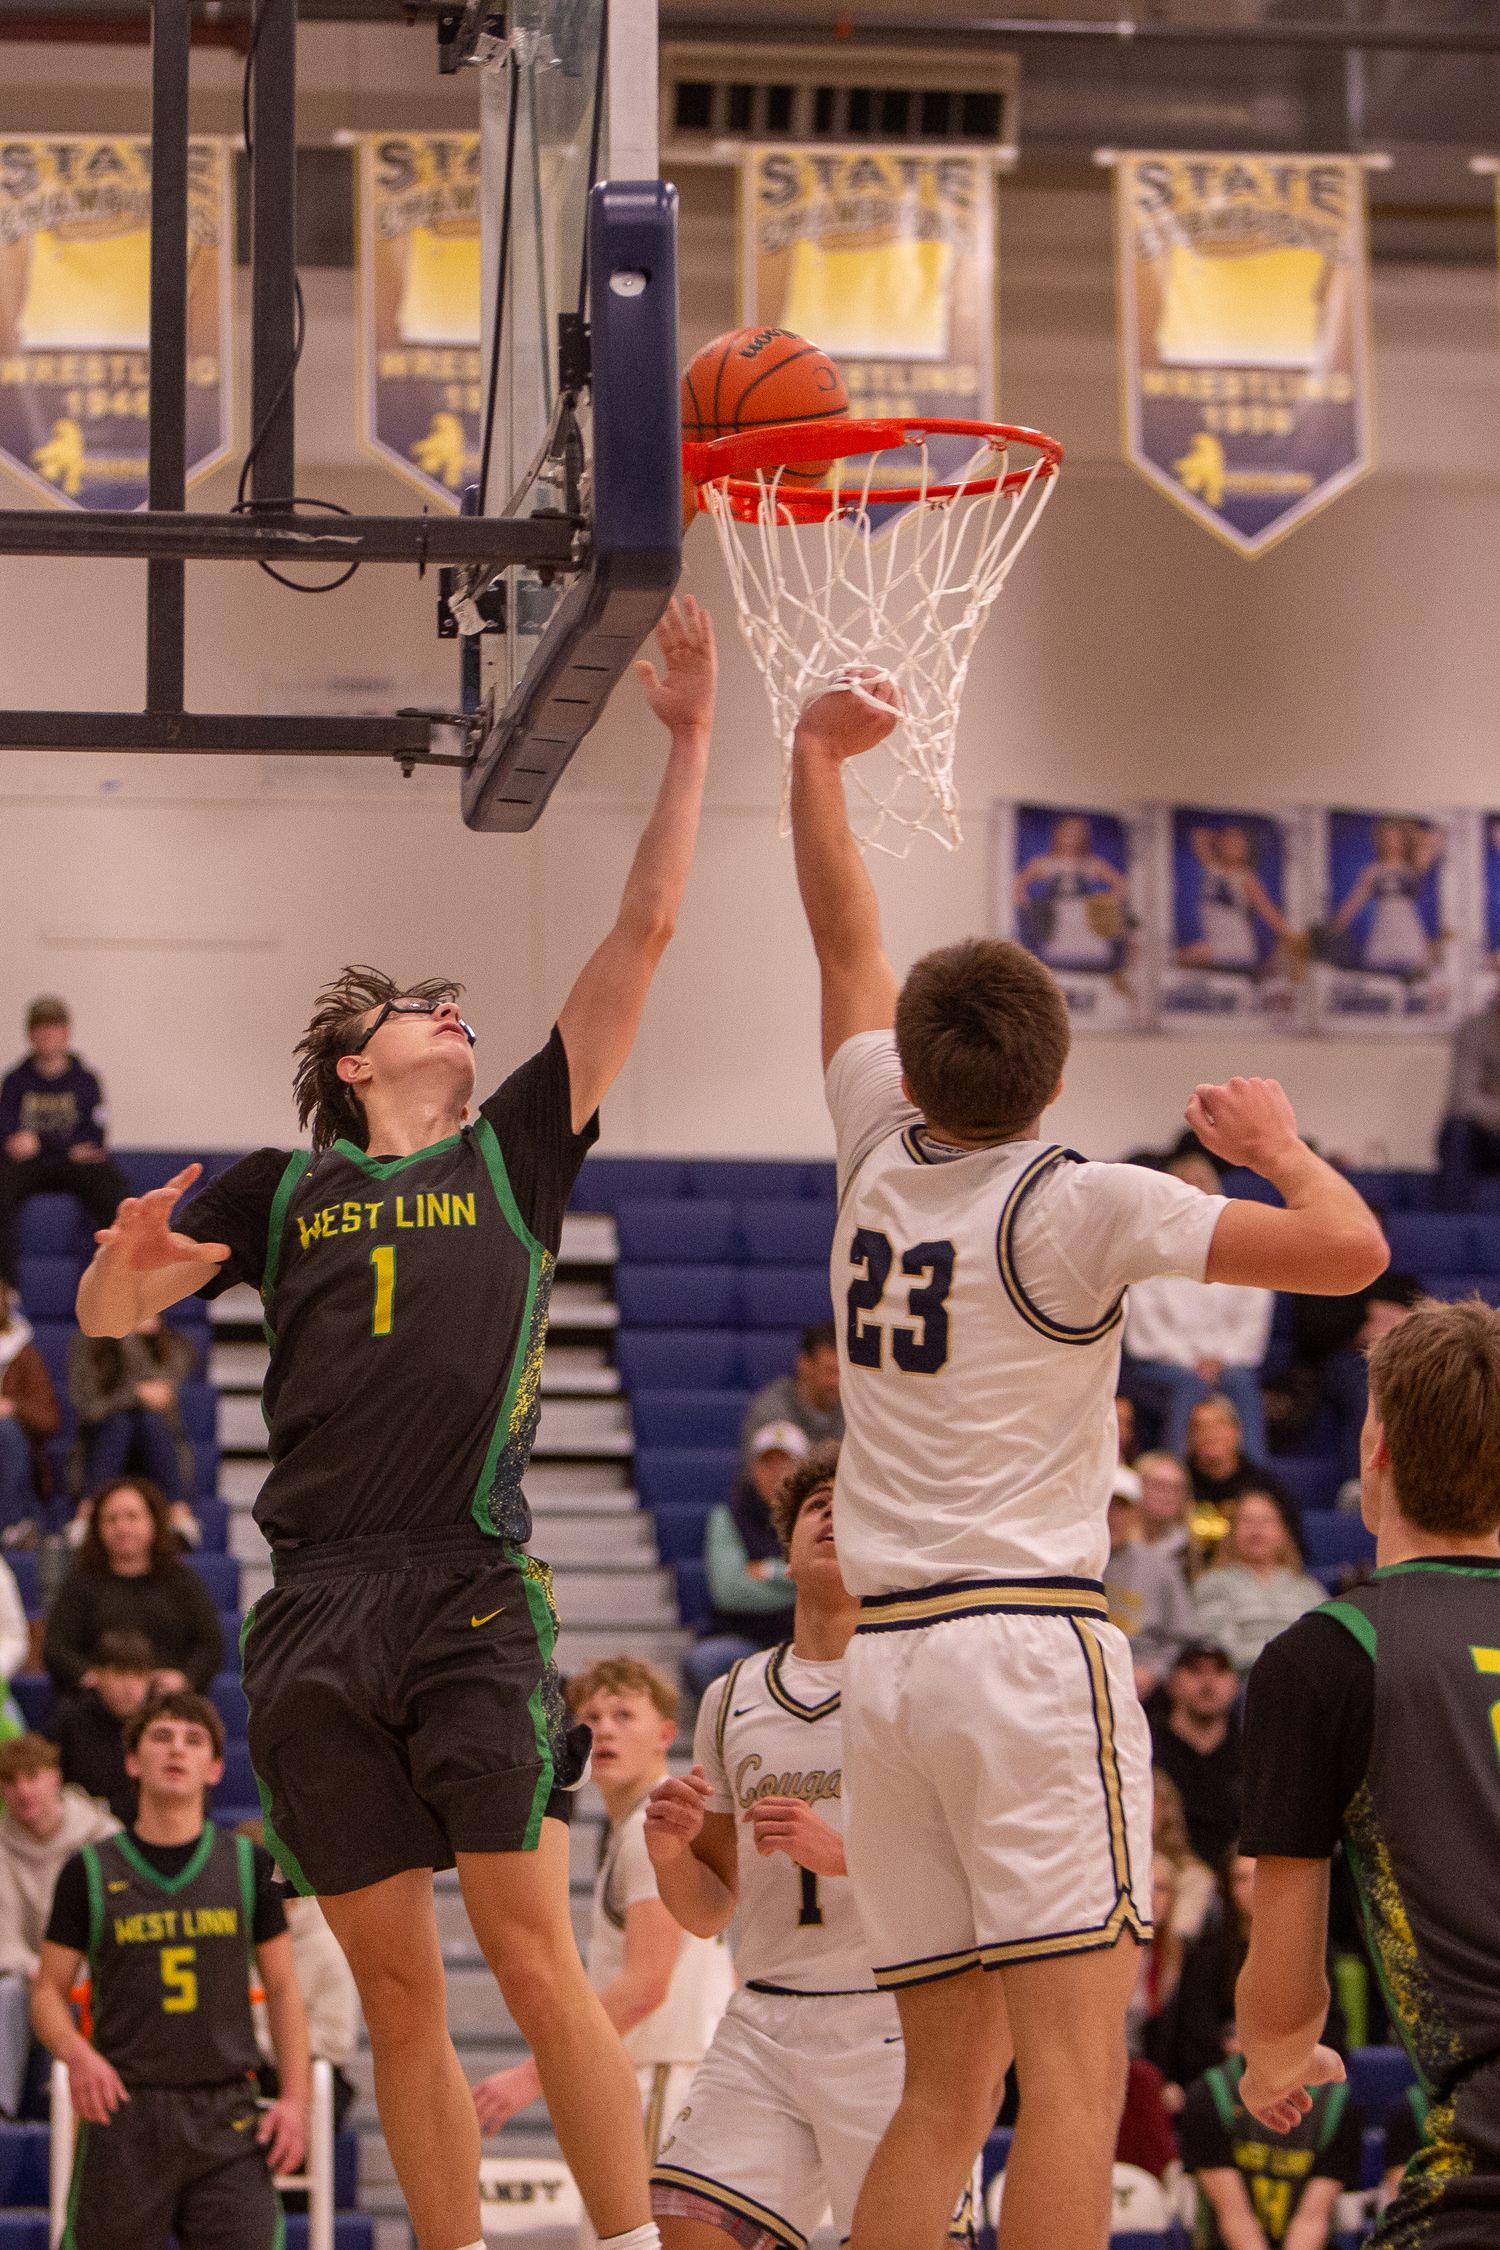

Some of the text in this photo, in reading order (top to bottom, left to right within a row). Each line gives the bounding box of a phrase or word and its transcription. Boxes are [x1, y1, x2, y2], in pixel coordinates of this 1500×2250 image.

[1137, 162, 1346, 217] STATE
[297, 1192, 476, 1250] WEST LINN
[370, 1245, 396, 1336] 1
[847, 1225, 957, 1377] 23
[114, 1907, 238, 1945] WEST LINN
[160, 1946, 198, 2013] 5
